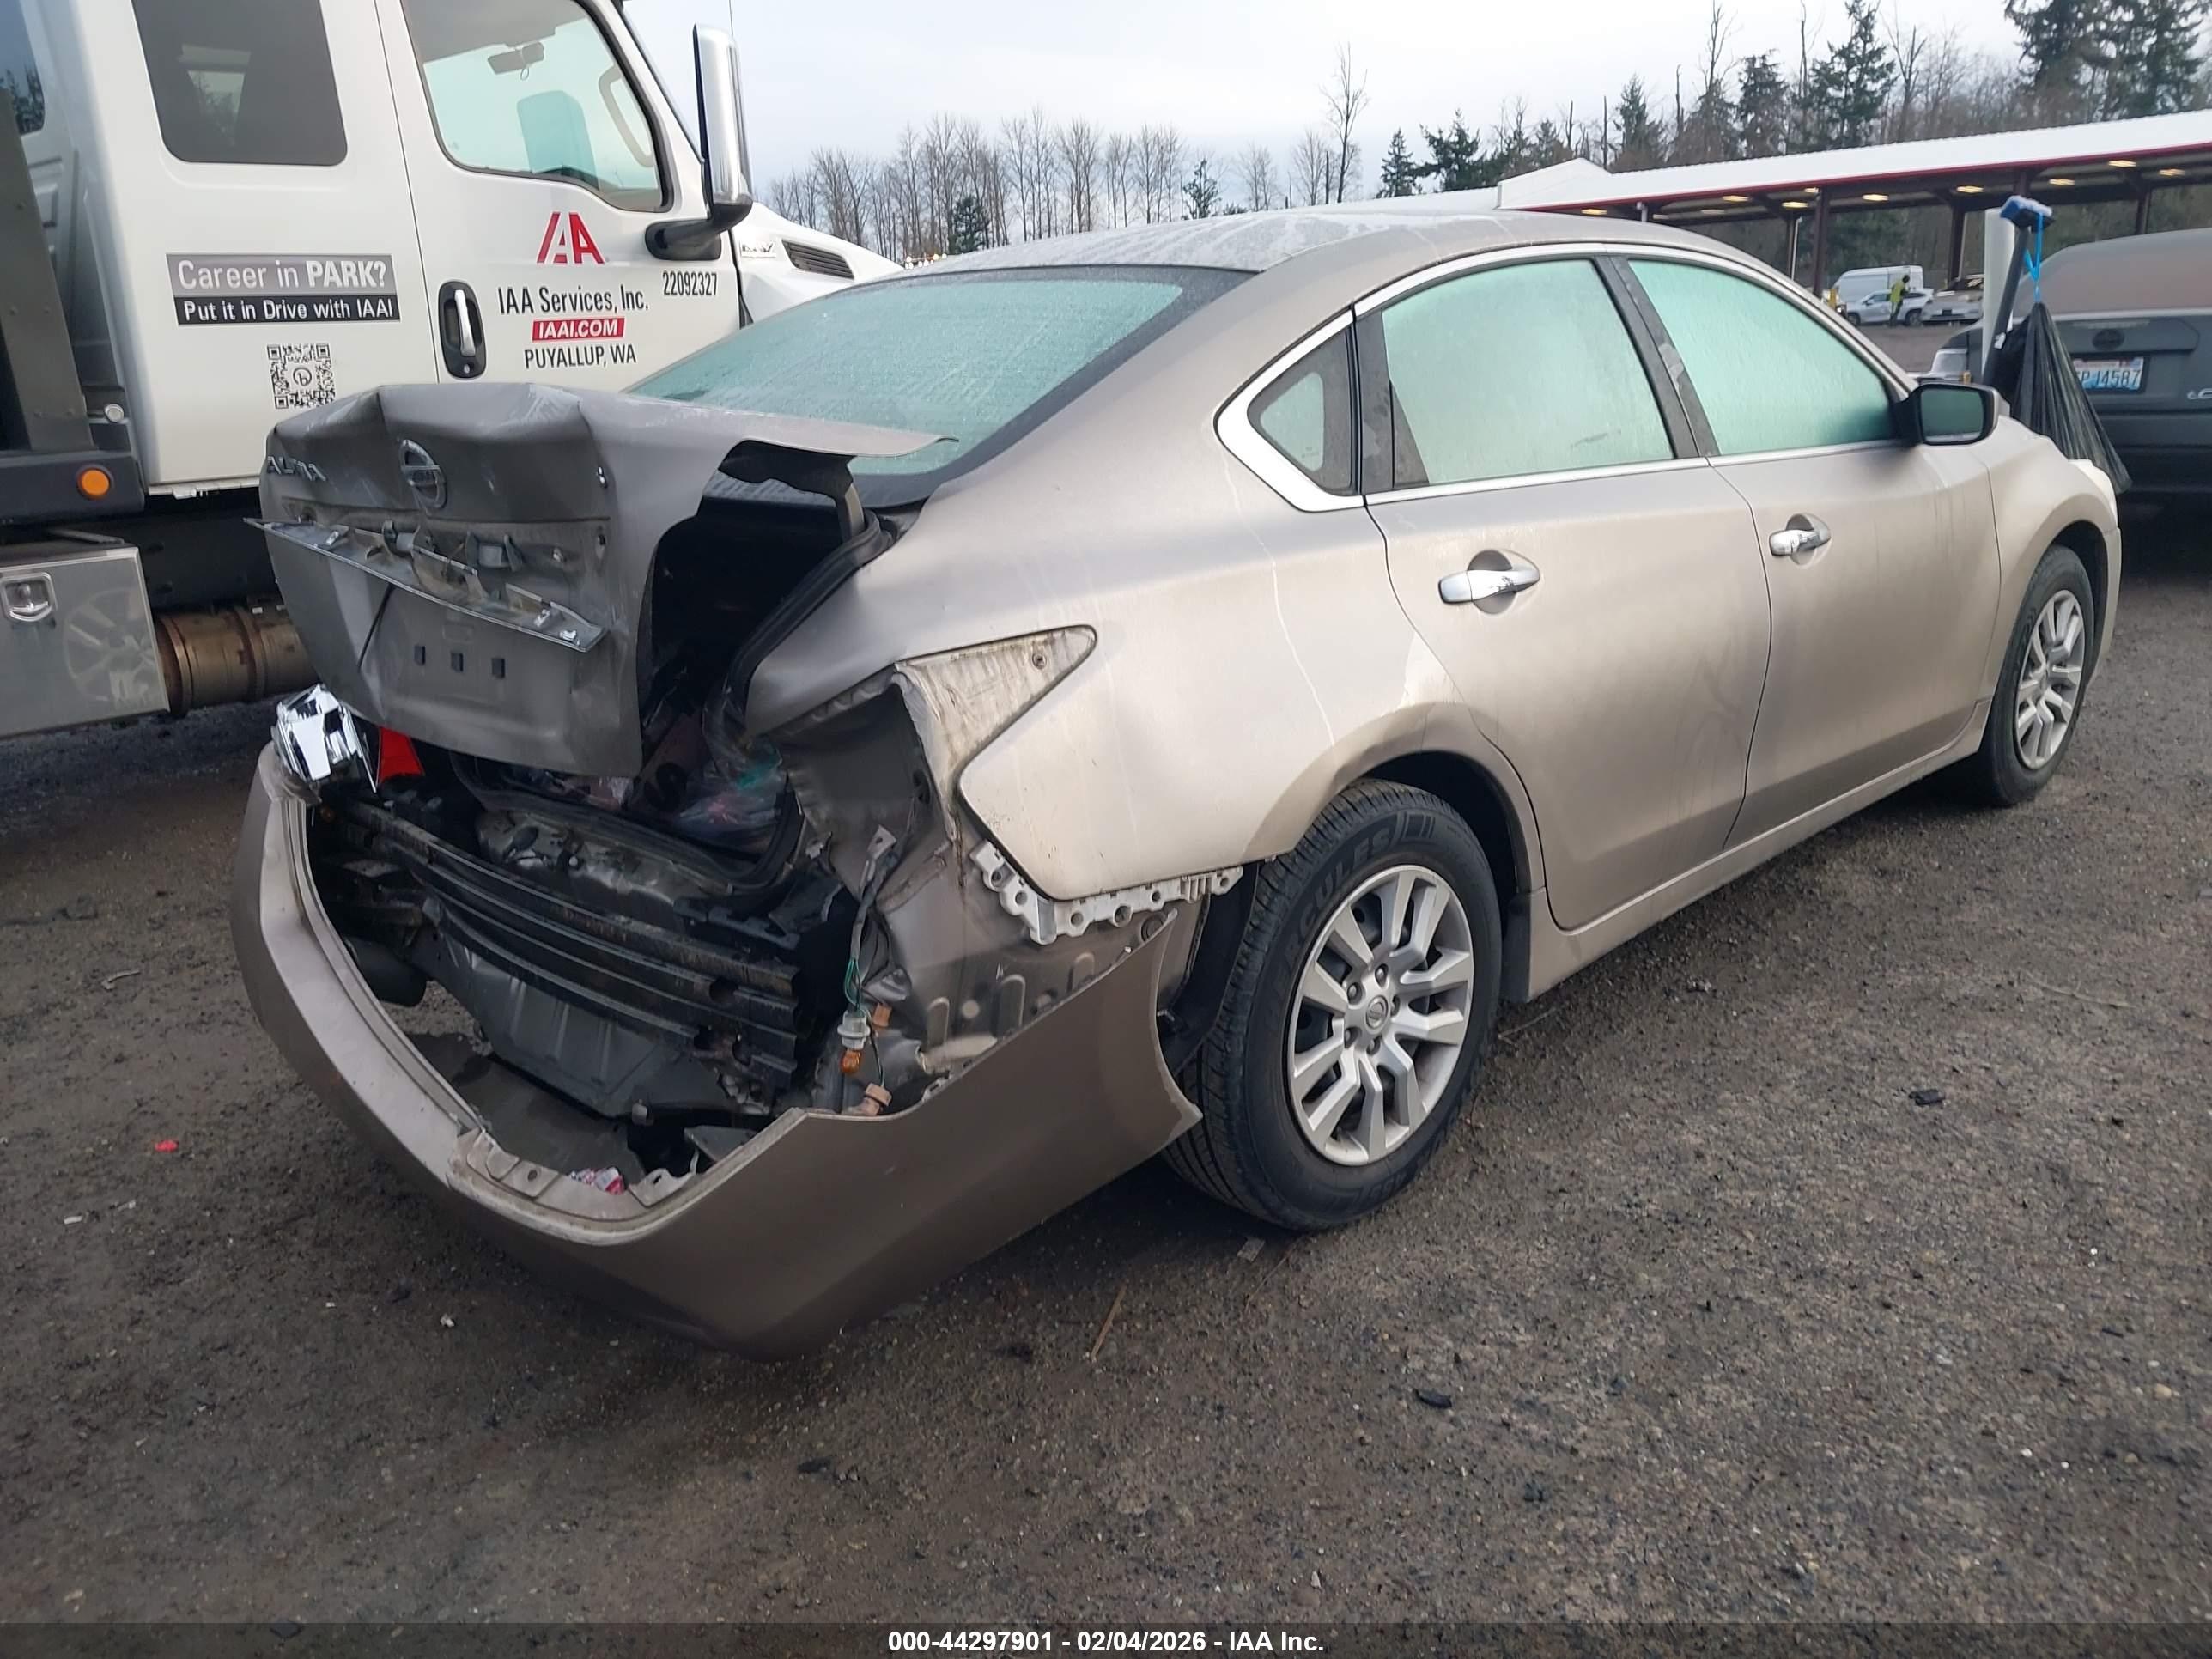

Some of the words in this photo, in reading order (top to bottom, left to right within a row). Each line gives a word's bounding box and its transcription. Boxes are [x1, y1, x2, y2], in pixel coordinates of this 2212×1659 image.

[178, 259, 266, 290] Career
[275, 259, 299, 289] in
[305, 260, 386, 289] PARK?
[662, 270, 718, 296] 22092327
[184, 301, 216, 321] Put
[222, 300, 236, 320] it
[240, 300, 256, 319] in
[263, 299, 307, 319] Drive
[313, 298, 350, 319] with
[356, 298, 393, 318] IAAI
[497, 286, 534, 314] IAA
[538, 285, 617, 314] Services,
[620, 284, 649, 311] Inc.
[538, 319, 618, 339] IAAI.COM
[524, 345, 606, 369] PUYALLUP,
[610, 343, 637, 364] WA
